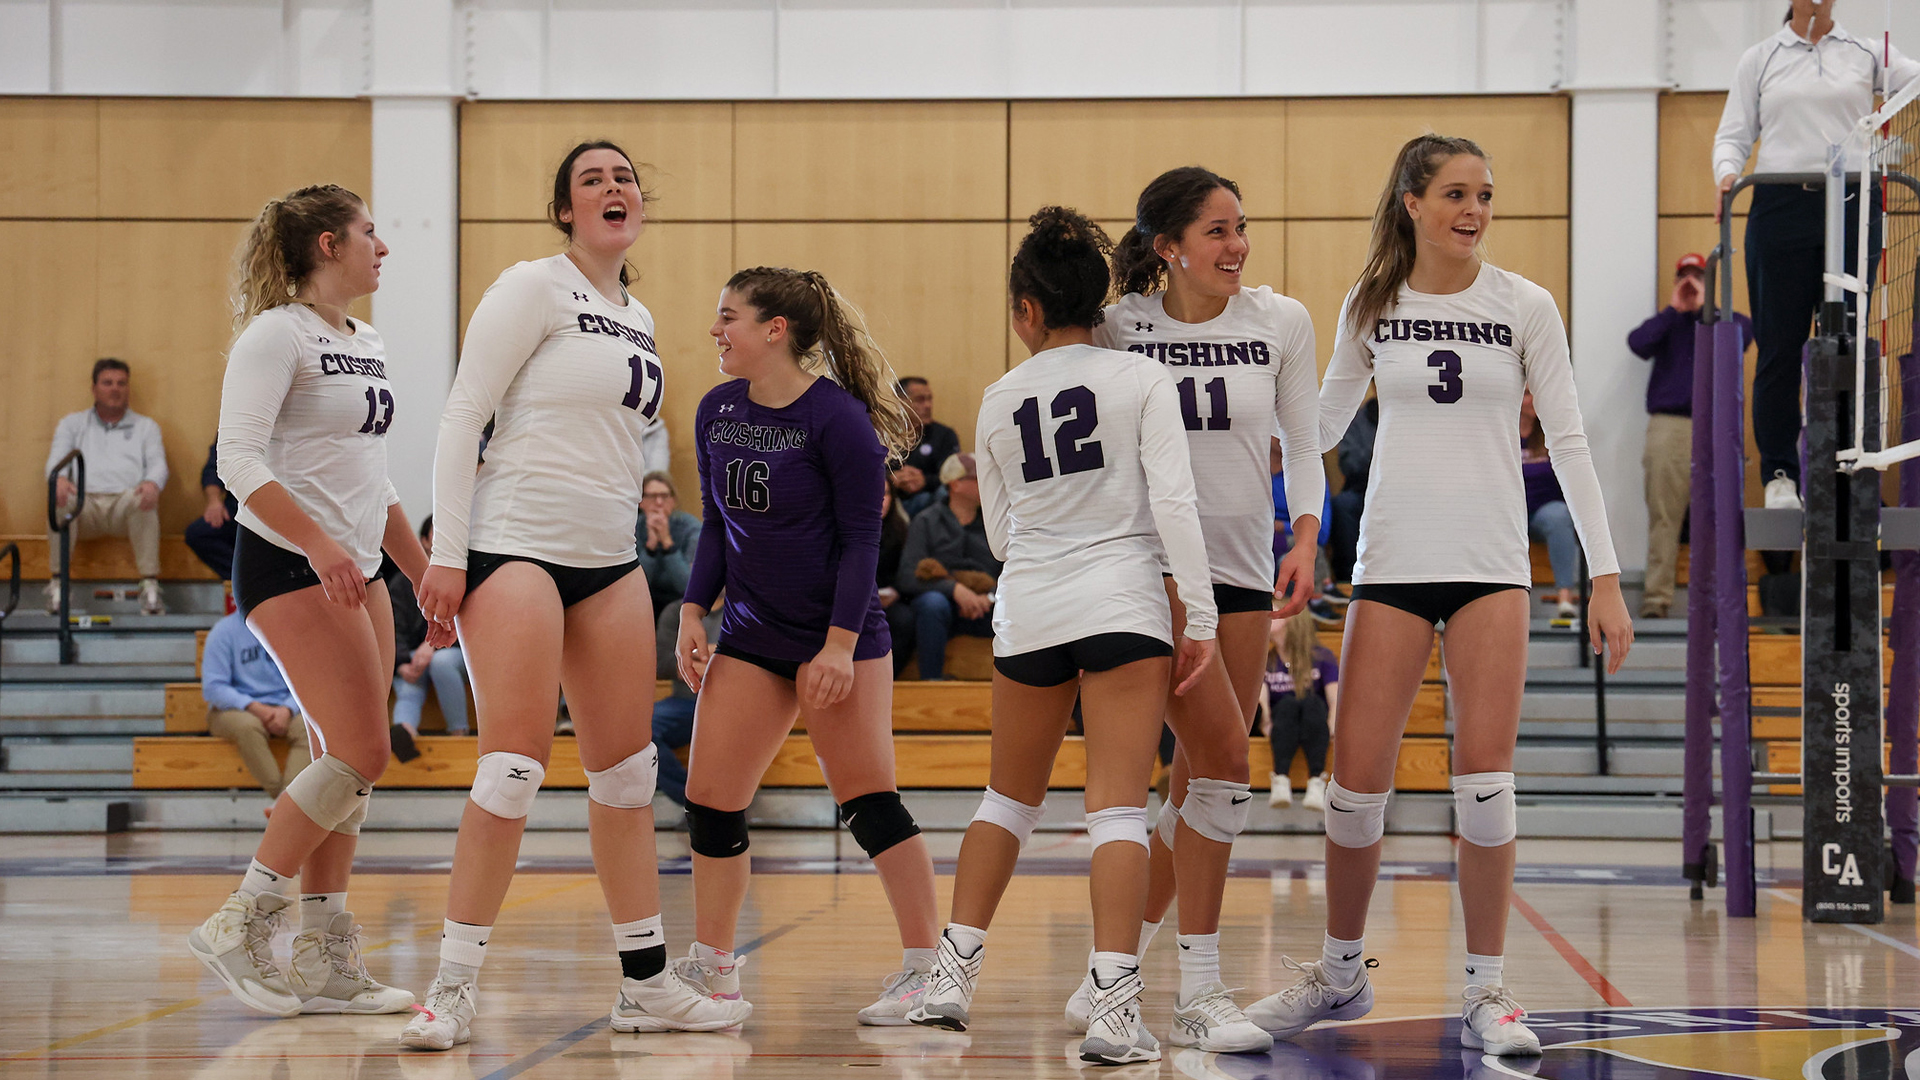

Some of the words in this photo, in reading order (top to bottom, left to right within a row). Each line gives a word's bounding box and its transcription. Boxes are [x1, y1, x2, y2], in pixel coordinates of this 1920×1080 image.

[1374, 318, 1512, 347] CUSHING
[621, 354, 663, 420] 17
[1176, 377, 1232, 431] 11
[1427, 350, 1463, 404] 3
[358, 386, 395, 435] 13
[709, 418, 807, 452] CUSHING
[1012, 384, 1105, 484] 12
[725, 458, 770, 512] 16
[1831, 682, 1853, 744] sports
[1831, 747, 1854, 823] imports
[1822, 842, 1864, 886] CA
